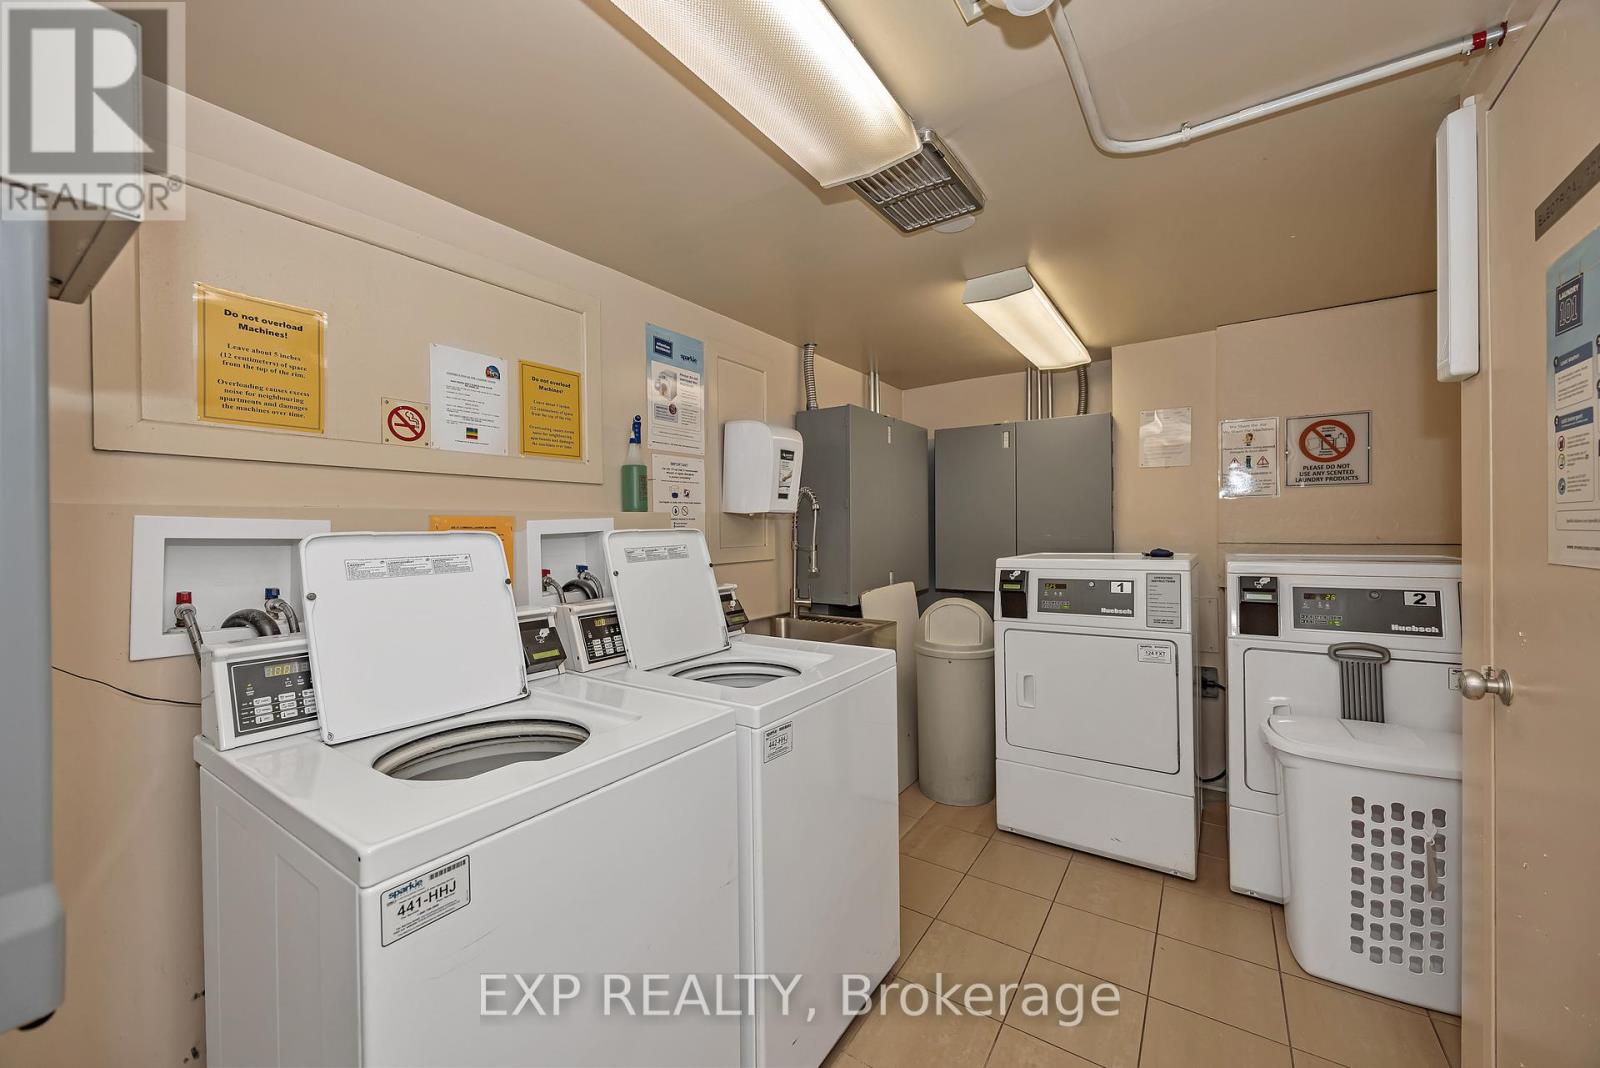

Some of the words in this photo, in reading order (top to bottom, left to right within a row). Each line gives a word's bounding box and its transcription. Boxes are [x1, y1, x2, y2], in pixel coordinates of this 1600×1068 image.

[1559, 283, 1579, 300] LAUNDRY
[1560, 295, 1577, 327] 101
[224, 308, 238, 318] Do
[242, 314, 260, 323] not
[261, 317, 304, 332] overload
[238, 323, 288, 339] Machines!
[227, 343, 249, 352] Leave
[251, 347, 272, 356] about
[222, 360, 241, 368] from
[256, 366, 268, 374] top
[234, 354, 279, 367] centimeters)
[217, 378, 264, 391] Overloading
[219, 395, 262, 406] apartments
[236, 405, 270, 414] machines
[1116, 582, 1124, 593] 1
[1413, 592, 1428, 605] 2
[1100, 607, 1132, 615] Huebsch
[1391, 623, 1440, 633] Huebsch
[397, 880, 456, 916] 441-HHJ
